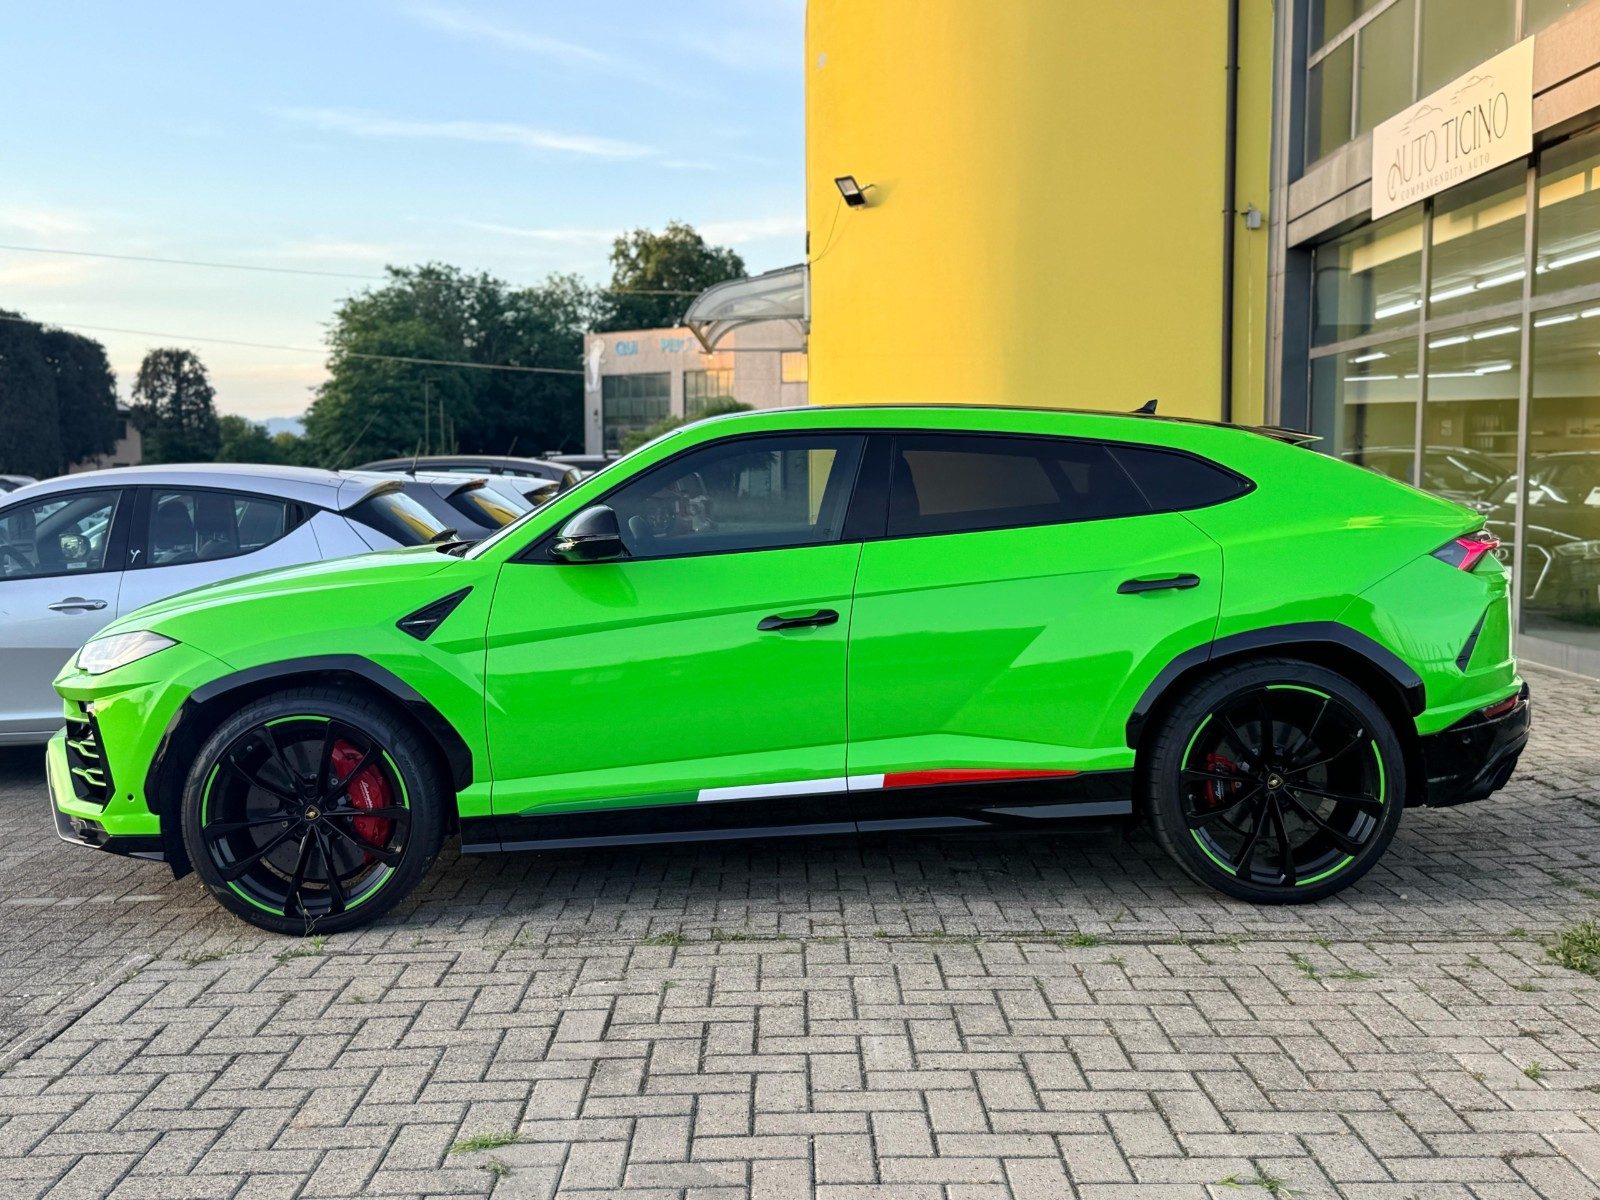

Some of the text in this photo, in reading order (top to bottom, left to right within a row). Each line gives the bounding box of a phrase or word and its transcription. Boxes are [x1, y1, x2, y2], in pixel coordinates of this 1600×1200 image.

[1387, 91, 1509, 202] AUTO TICINO
[1401, 152, 1490, 201] COMPRAVENDITA AUTO
